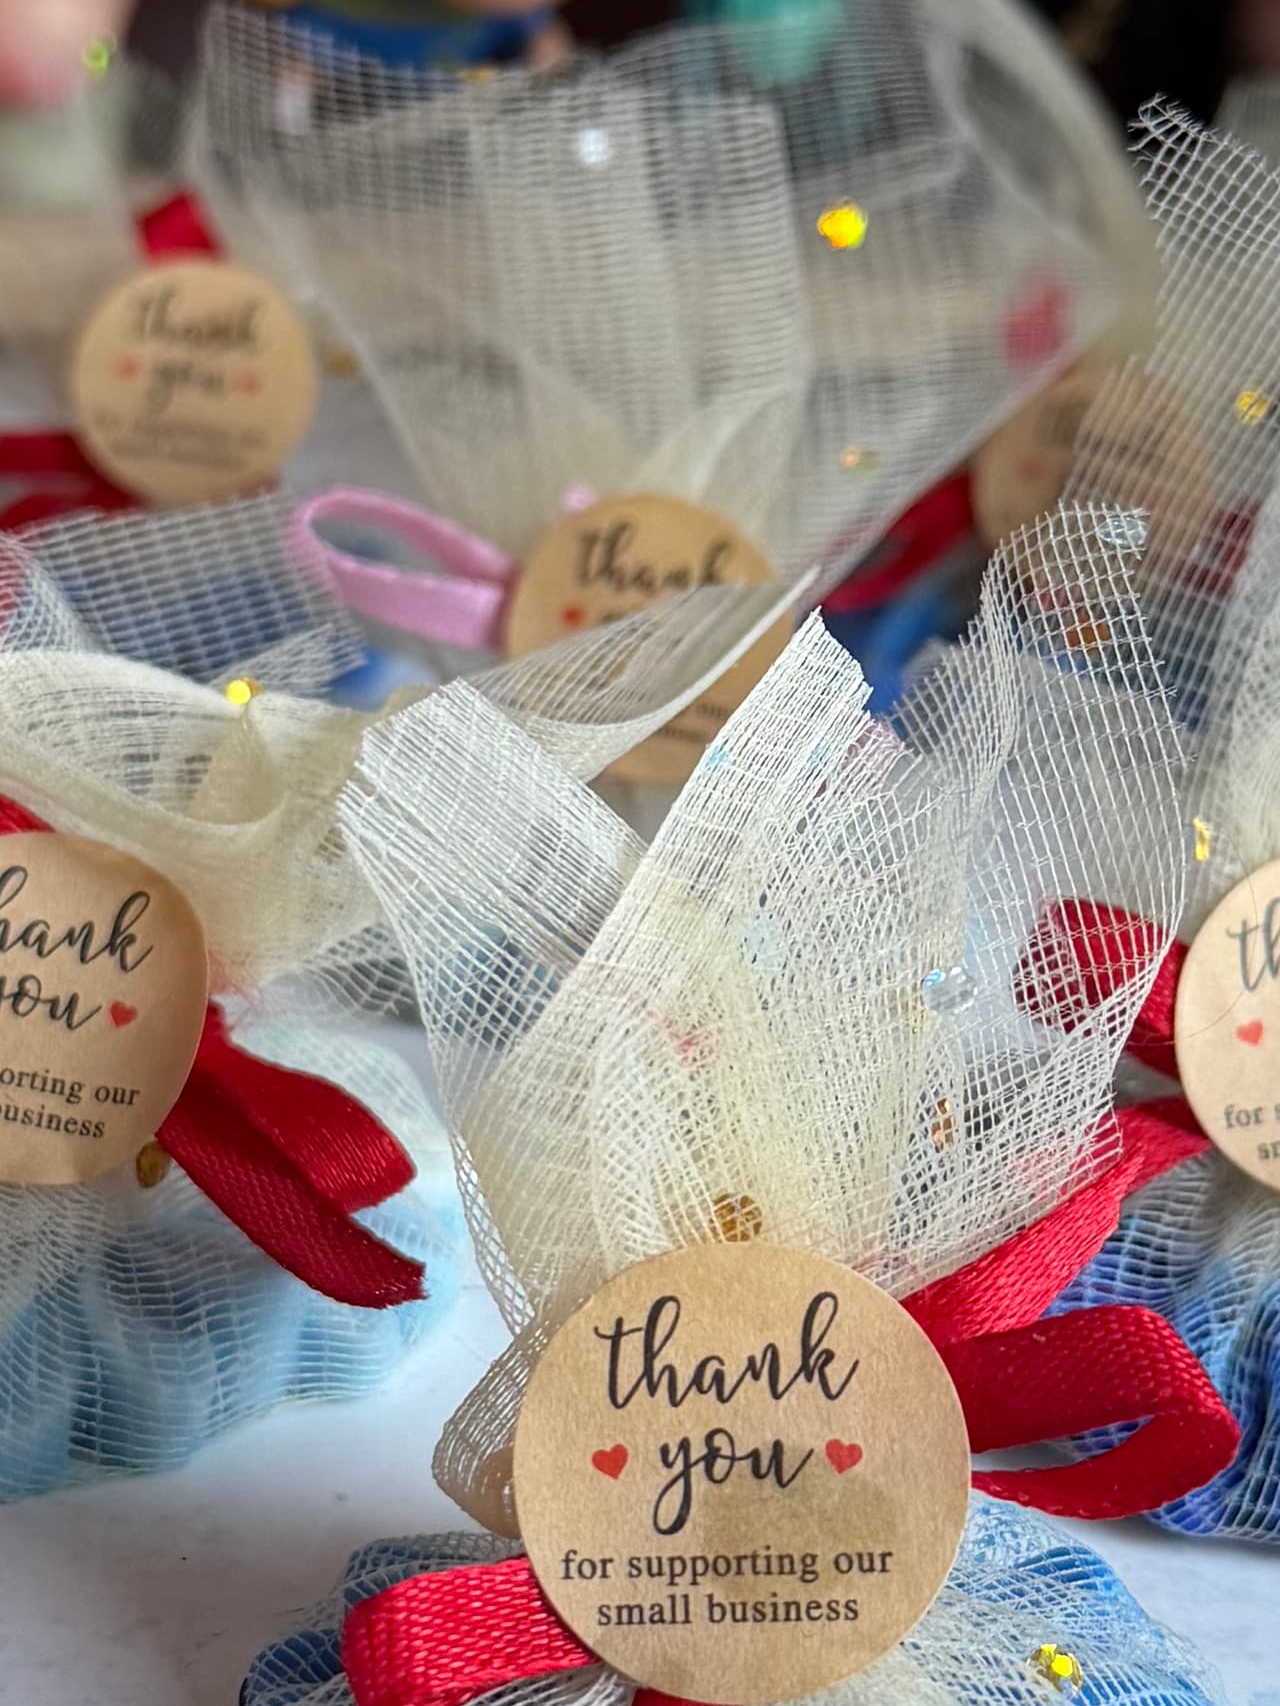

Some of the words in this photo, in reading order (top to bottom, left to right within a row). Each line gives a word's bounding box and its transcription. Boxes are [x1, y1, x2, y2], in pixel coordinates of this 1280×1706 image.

[94, 1082, 140, 1106] our
[1223, 1103, 1263, 1130] for
[594, 1291, 859, 1409] thank
[652, 1427, 814, 1536] you
[561, 1549, 614, 1581] for
[628, 1545, 819, 1586] supporting
[833, 1550, 893, 1575] our
[597, 1594, 692, 1626] small
[708, 1592, 859, 1624] business
